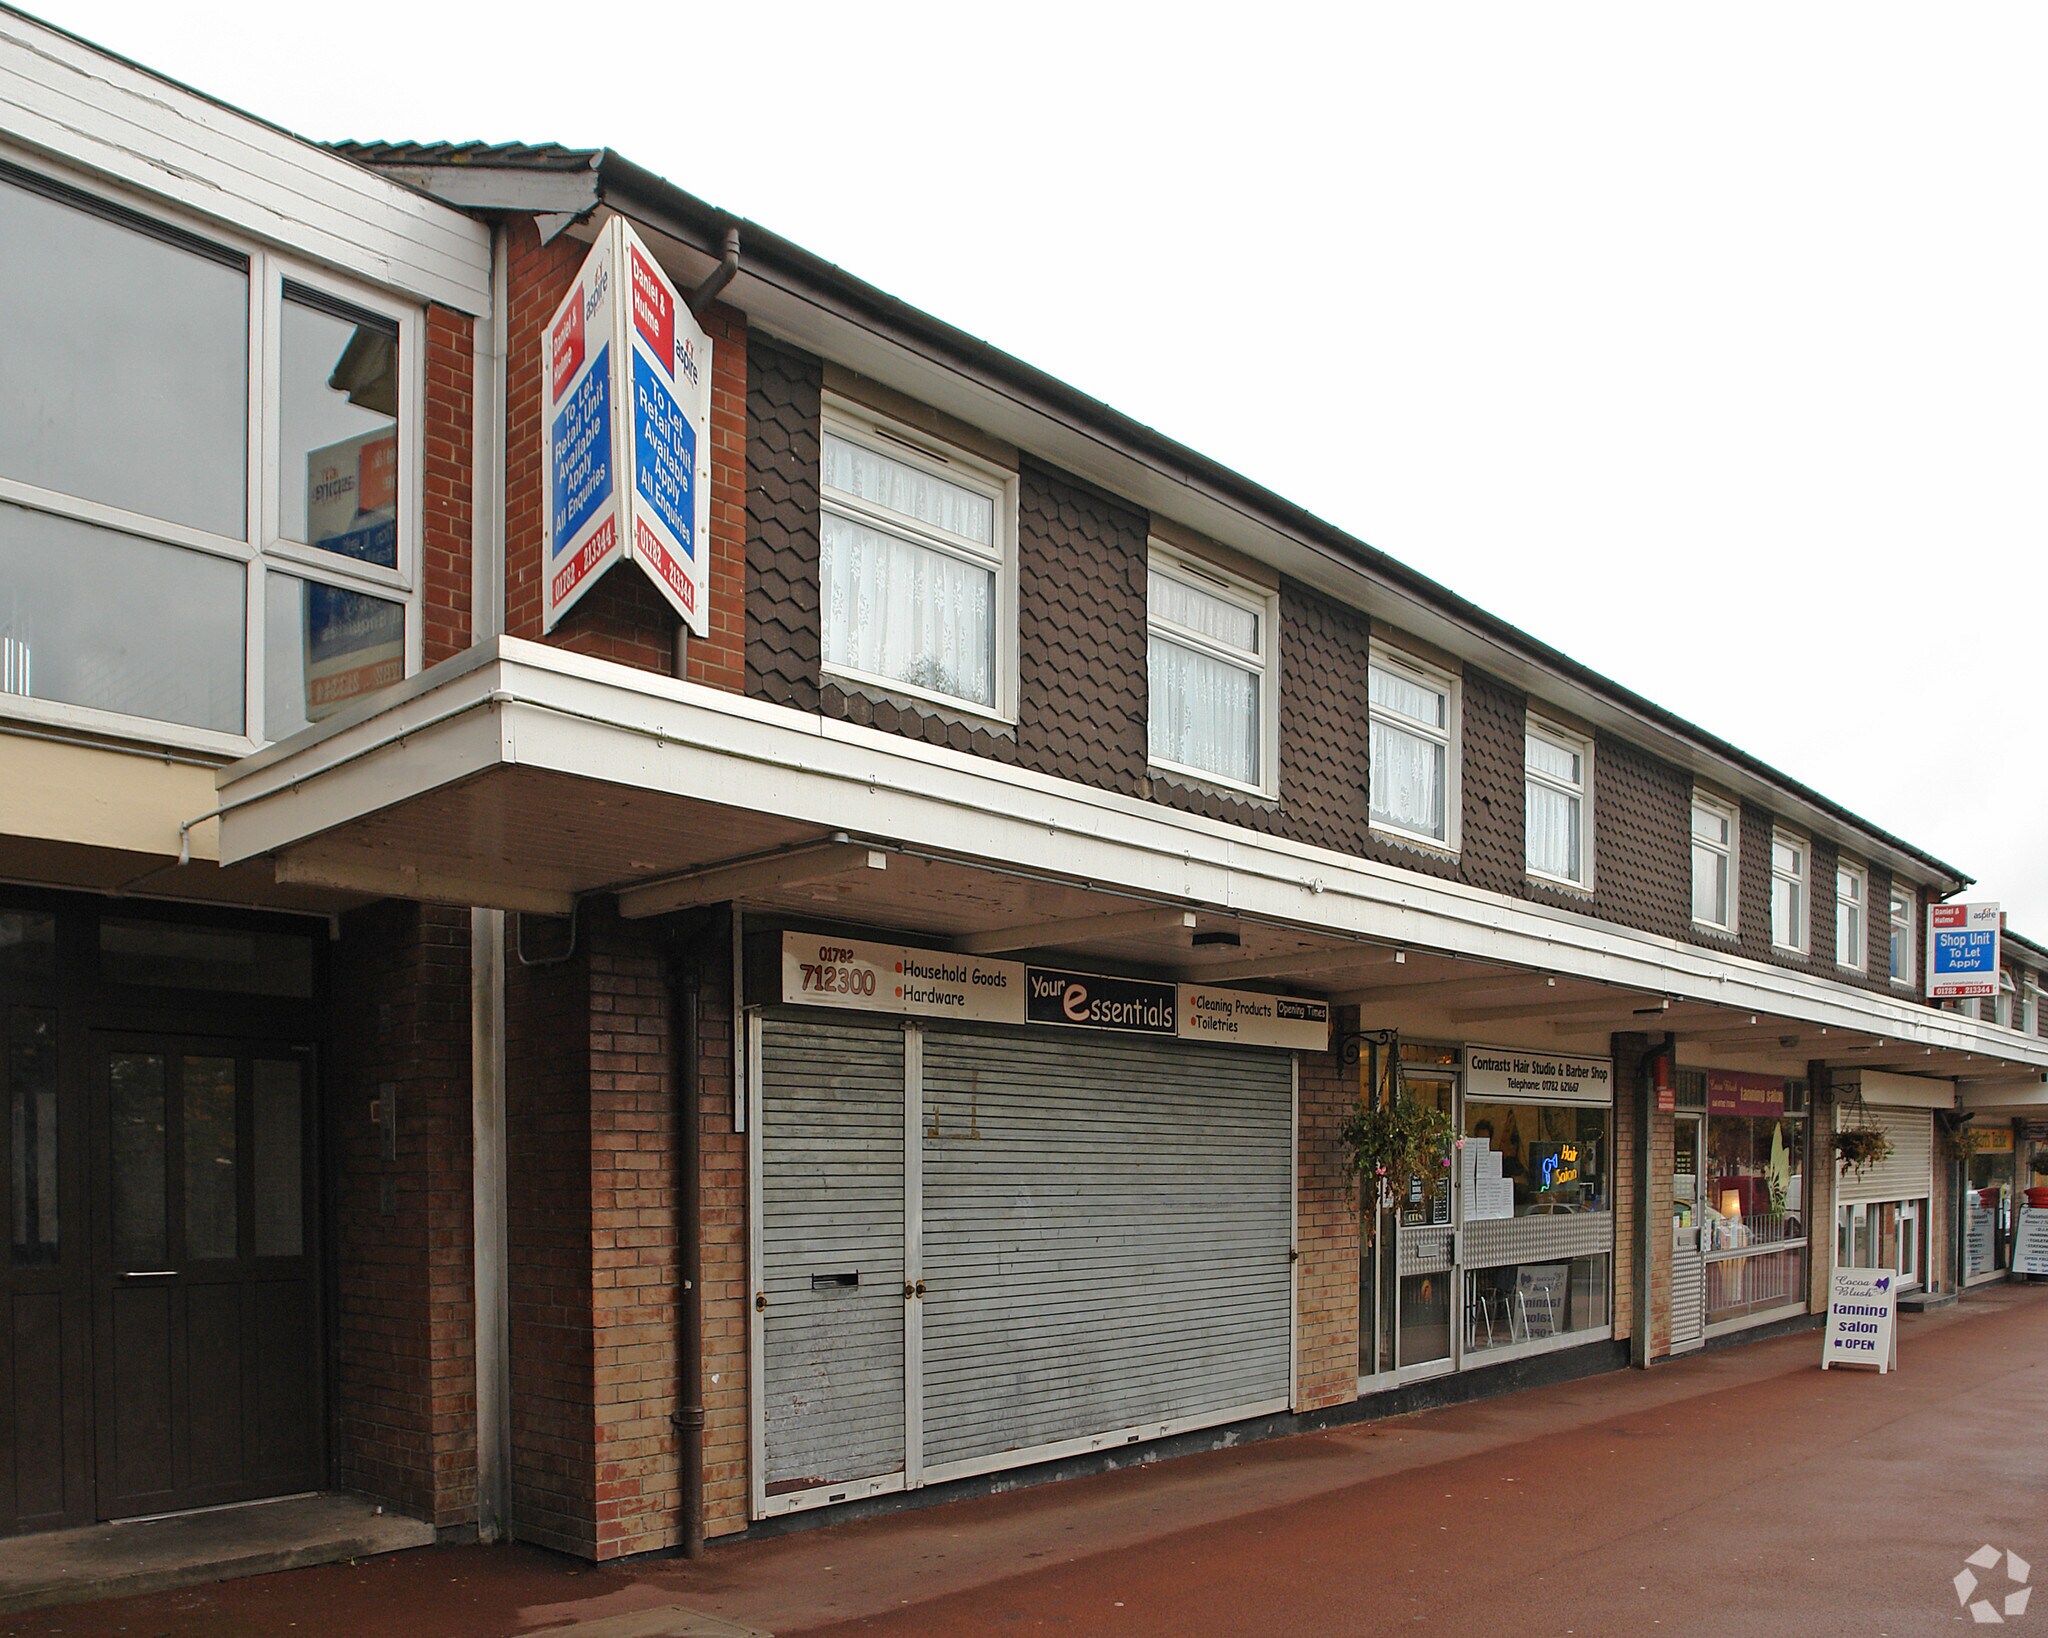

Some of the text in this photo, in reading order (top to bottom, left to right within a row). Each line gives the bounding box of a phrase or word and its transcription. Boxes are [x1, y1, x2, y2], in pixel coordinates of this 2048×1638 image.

[585, 271, 608, 321] aspire
[633, 257, 666, 317] Daniel &
[634, 288, 659, 337] Hulme
[554, 313, 572, 358] Daniel
[554, 346, 573, 387] Hulme
[676, 339, 698, 385] aspire
[564, 371, 594, 427] To Let
[650, 376, 683, 439] To Let
[555, 380, 604, 464] Retail Unit
[639, 385, 691, 474] Retail Unit
[559, 416, 601, 484] Available
[644, 420, 688, 493] Available
[567, 451, 592, 495] Apply
[654, 457, 681, 507] Apply
[555, 462, 606, 536] All Enquiries
[640, 466, 691, 546] All Enquiries
[554, 522, 612, 601] 01782 213344
[640, 525, 692, 607] 01782 213344
[1934, 908, 1954, 916] Daniel
[1934, 916, 1954, 924] Hulme
[1973, 909, 1997, 921] aspire
[1940, 932, 1991, 948] Shop Unit
[1949, 948, 1981, 958] To Let
[818, 946, 854, 964] 01782
[1949, 959, 1981, 969] Apply
[800, 964, 876, 996] 712300
[903, 959, 1007, 988] Household Goods
[903, 984, 965, 1006] Hardware
[1031, 975, 1173, 1028] Your essentials
[1936, 985, 1990, 995] 01782 213344
[1196, 995, 1272, 1018] Cleaning Products
[1277, 1002, 1326, 1019] Opening Times
[1196, 1015, 1239, 1033] Toiletries
[1471, 1055, 1608, 1083] Contrasts Hair Studio & Barber Shop
[1507, 1078, 1540, 1092] Telephone:
[1541, 1080, 1559, 1092] 01782
[1560, 1144, 1578, 1162] Hair
[1835, 1275, 1871, 1286] Cocoa
[1835, 1286, 1873, 1297] Blush
[1833, 1303, 1888, 1318] tanning
[1838, 1321, 1878, 1334] salon
[1845, 1338, 1875, 1351] OPEN
